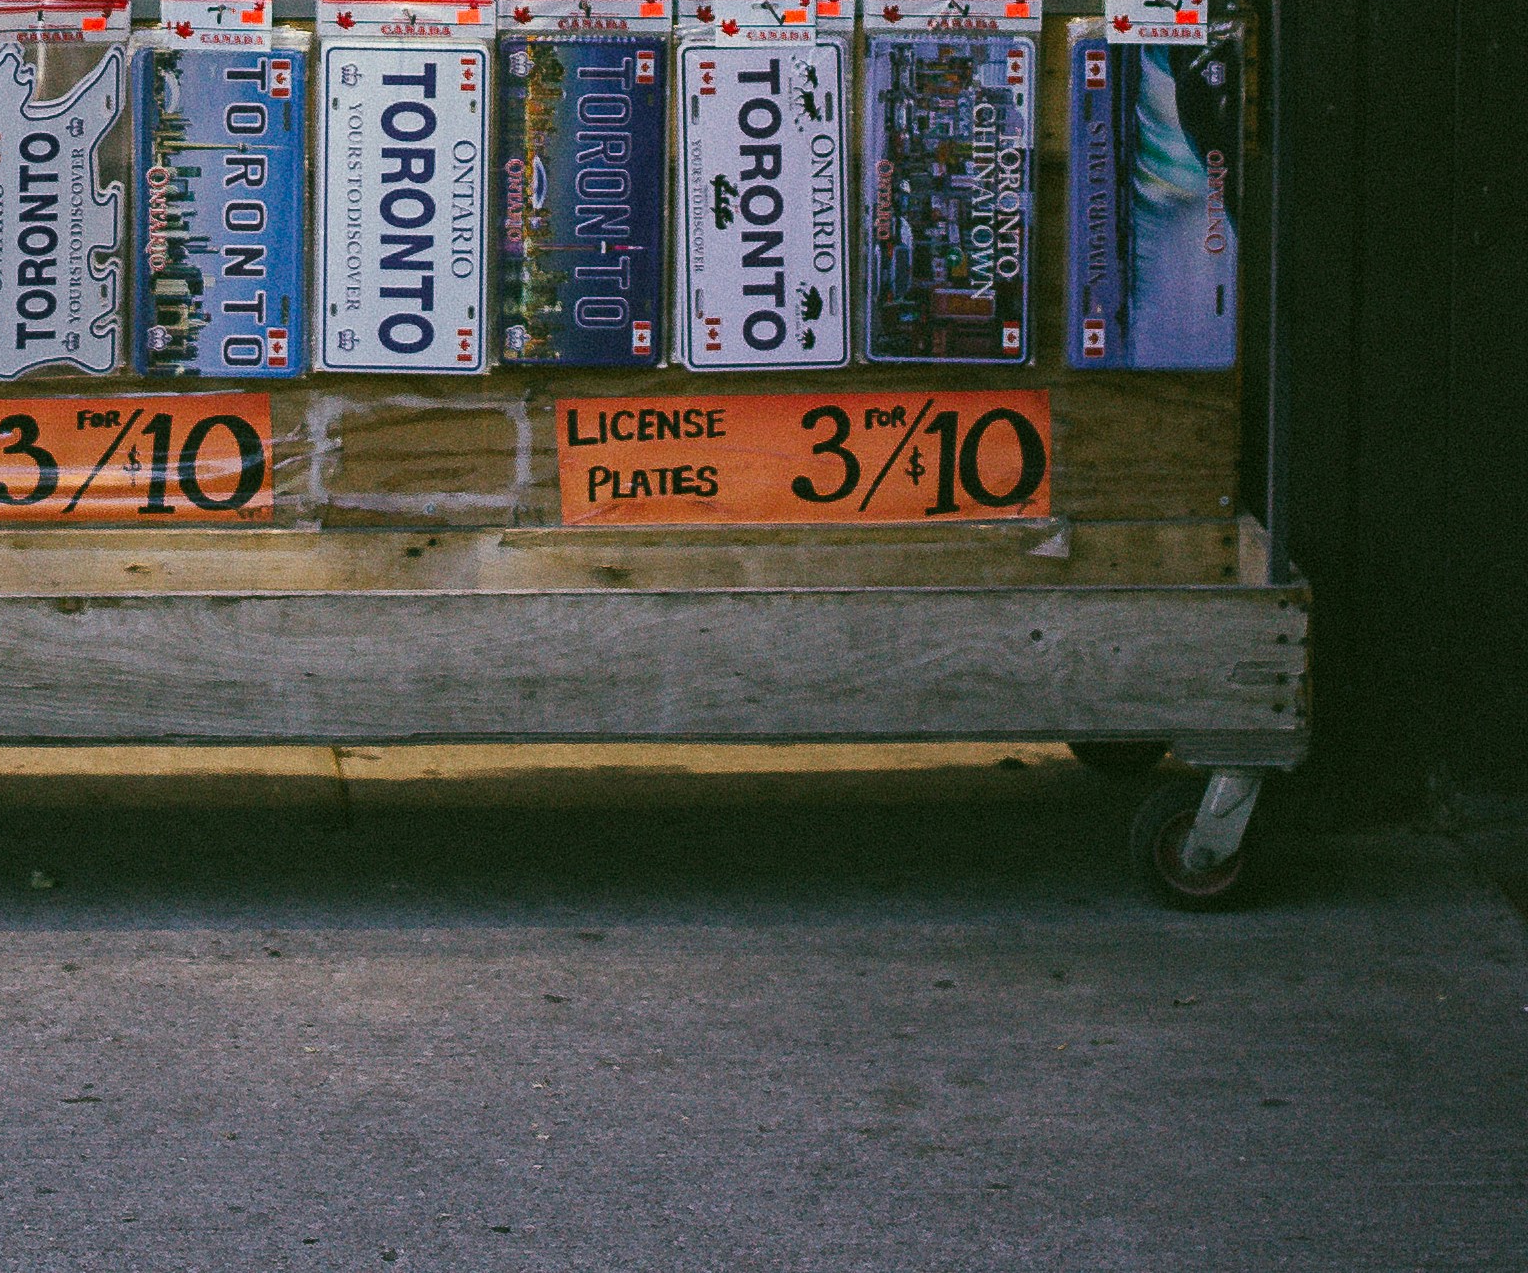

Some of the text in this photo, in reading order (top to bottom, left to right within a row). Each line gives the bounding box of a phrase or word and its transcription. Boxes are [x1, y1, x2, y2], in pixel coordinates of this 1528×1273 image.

[200, 33, 264, 45] CANADA
[381, 25, 451, 36] CANADA
[557, 19, 629, 30] CANADA
[747, 30, 811, 41] CANADA
[928, 19, 999, 29] CANADA
[1139, 27, 1202, 39] CANADA
[347, 102, 364, 171] YOURS
[15, 131, 61, 350] TORONTO
[69, 147, 85, 238] DISCOVER
[145, 165, 171, 272] ONTARIO
[222, 56, 269, 369] TORONTO
[377, 62, 438, 354] TORONTO
[450, 139, 478, 279] ONTARIO
[692, 208, 707, 273] DISCOVER
[737, 58, 788, 352] TORONTO
[810, 134, 837, 273] ONTARIO
[970, 102, 998, 300] CHINATOWN
[996, 126, 1022, 279] TORONTO
[1086, 120, 1109, 287] NIAGARA FALLS
[1202, 150, 1228, 256] ONTARIO
[66, 266, 82, 324] YOURS
[345, 206, 362, 312] DISCOVER
[566, 409, 726, 447] LICENSE
[790, 405, 861, 503] 3
[587, 465, 719, 503] PLATES
